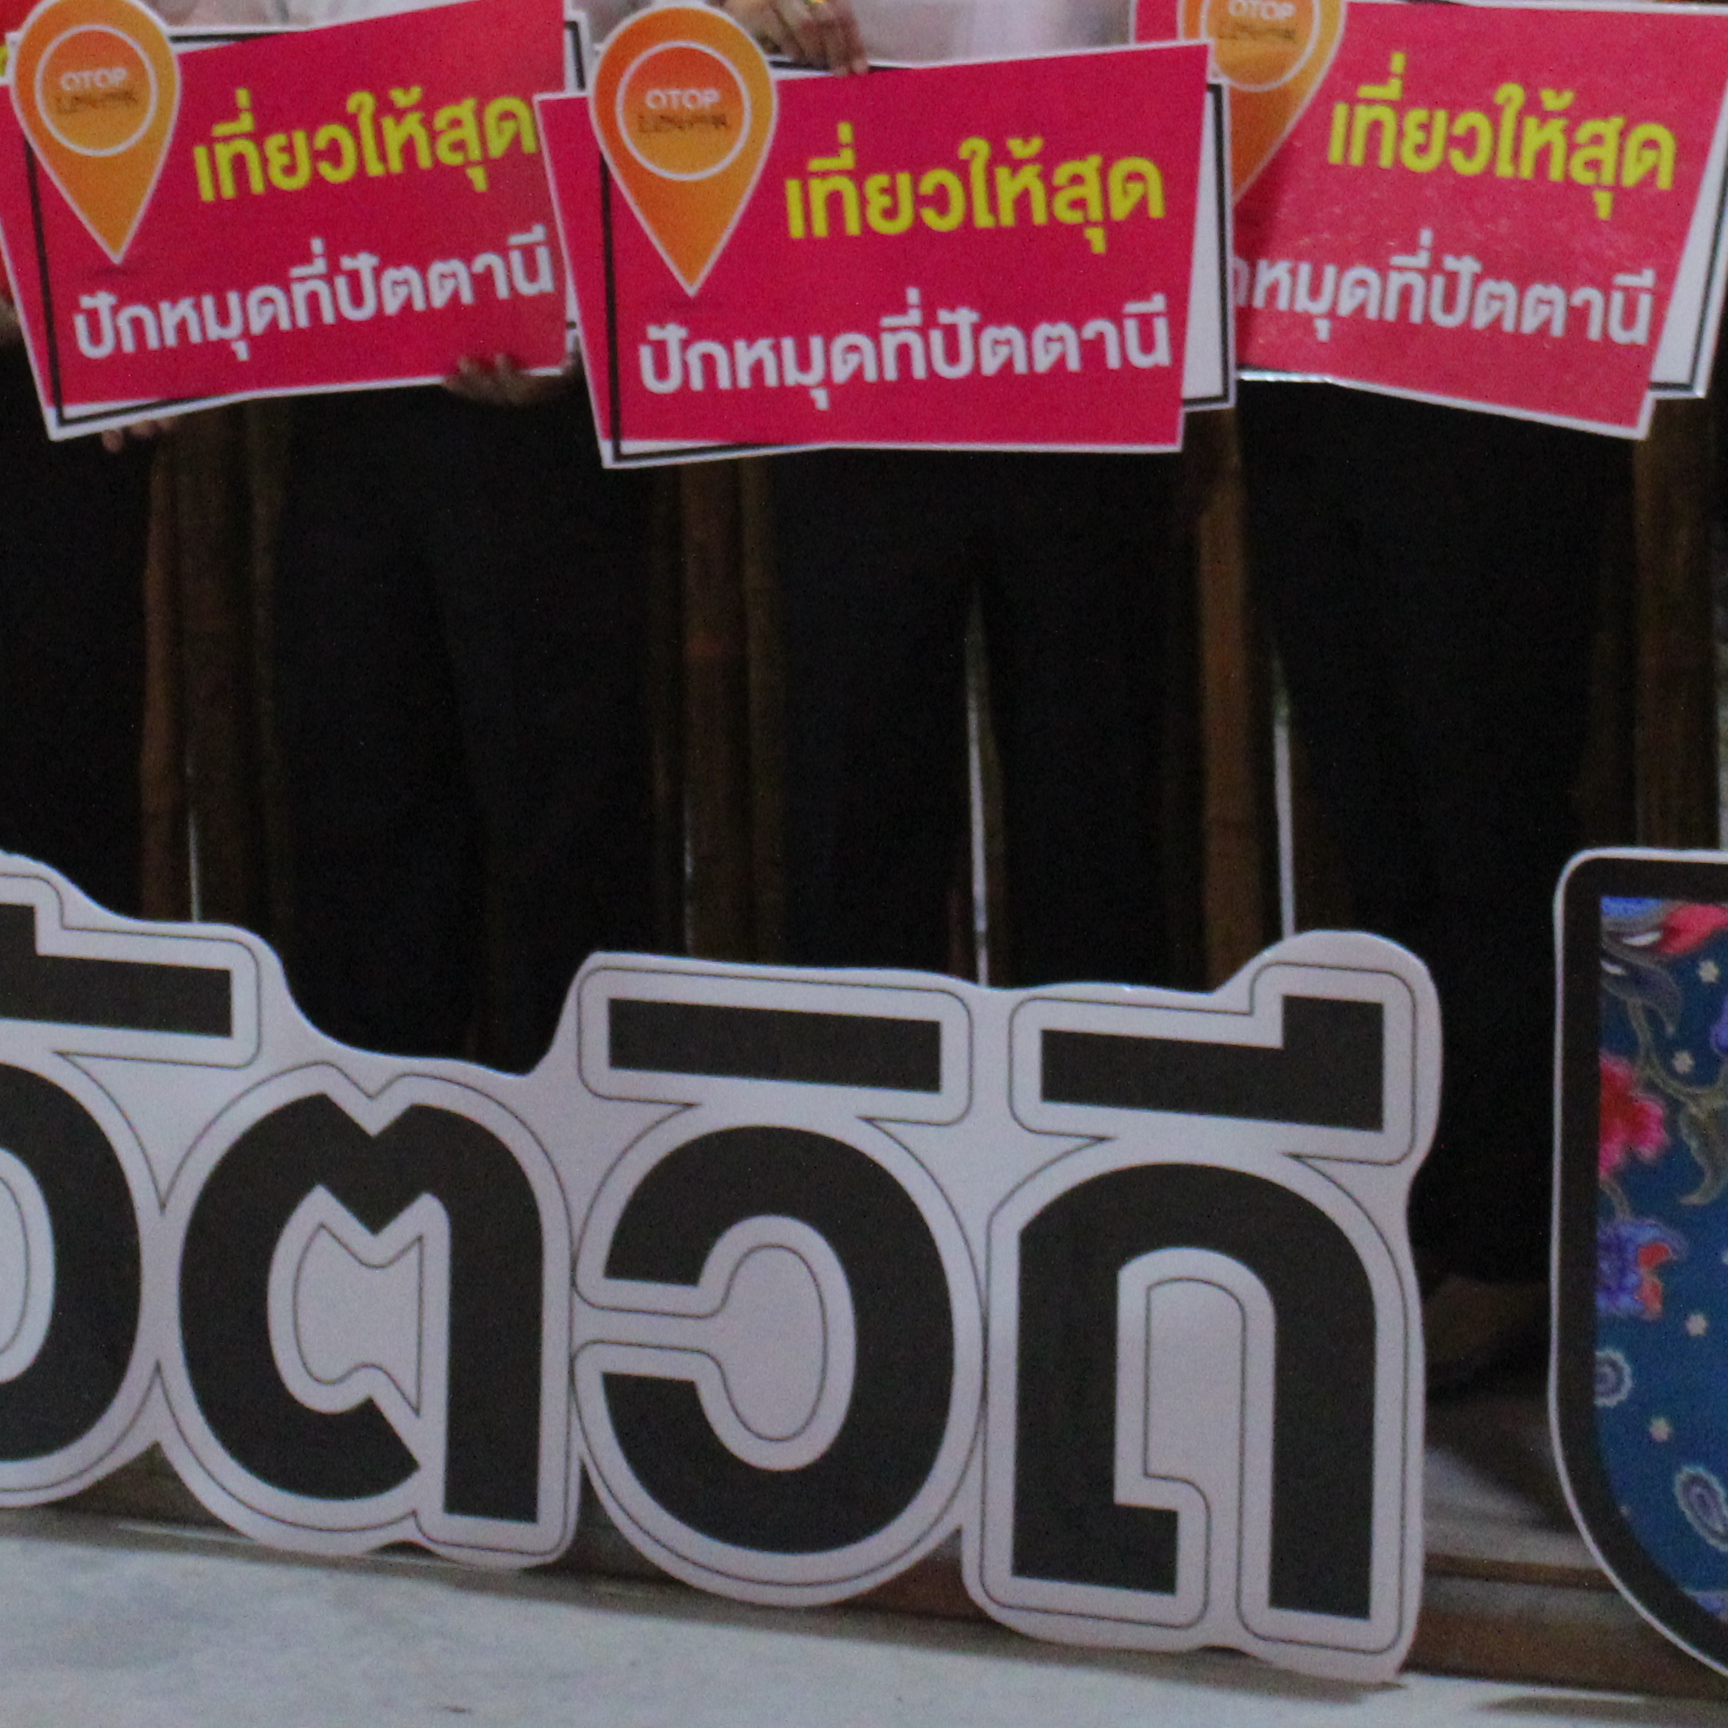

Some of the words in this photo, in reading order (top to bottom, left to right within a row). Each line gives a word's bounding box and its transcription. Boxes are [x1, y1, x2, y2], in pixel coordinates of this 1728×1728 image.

[193, 85, 537, 203] เที่ยวให้สุด
[645, 88, 722, 110] OTOP
[1327, 51, 1675, 220] เที่ยวให้สุด
[785, 121, 1165, 255] เที่ยวให้สุด
[74, 224, 556, 362] ปักหมุดที่ปัตตานี
[638, 287, 1171, 411] ปักหมุดที่ปัตตานี
